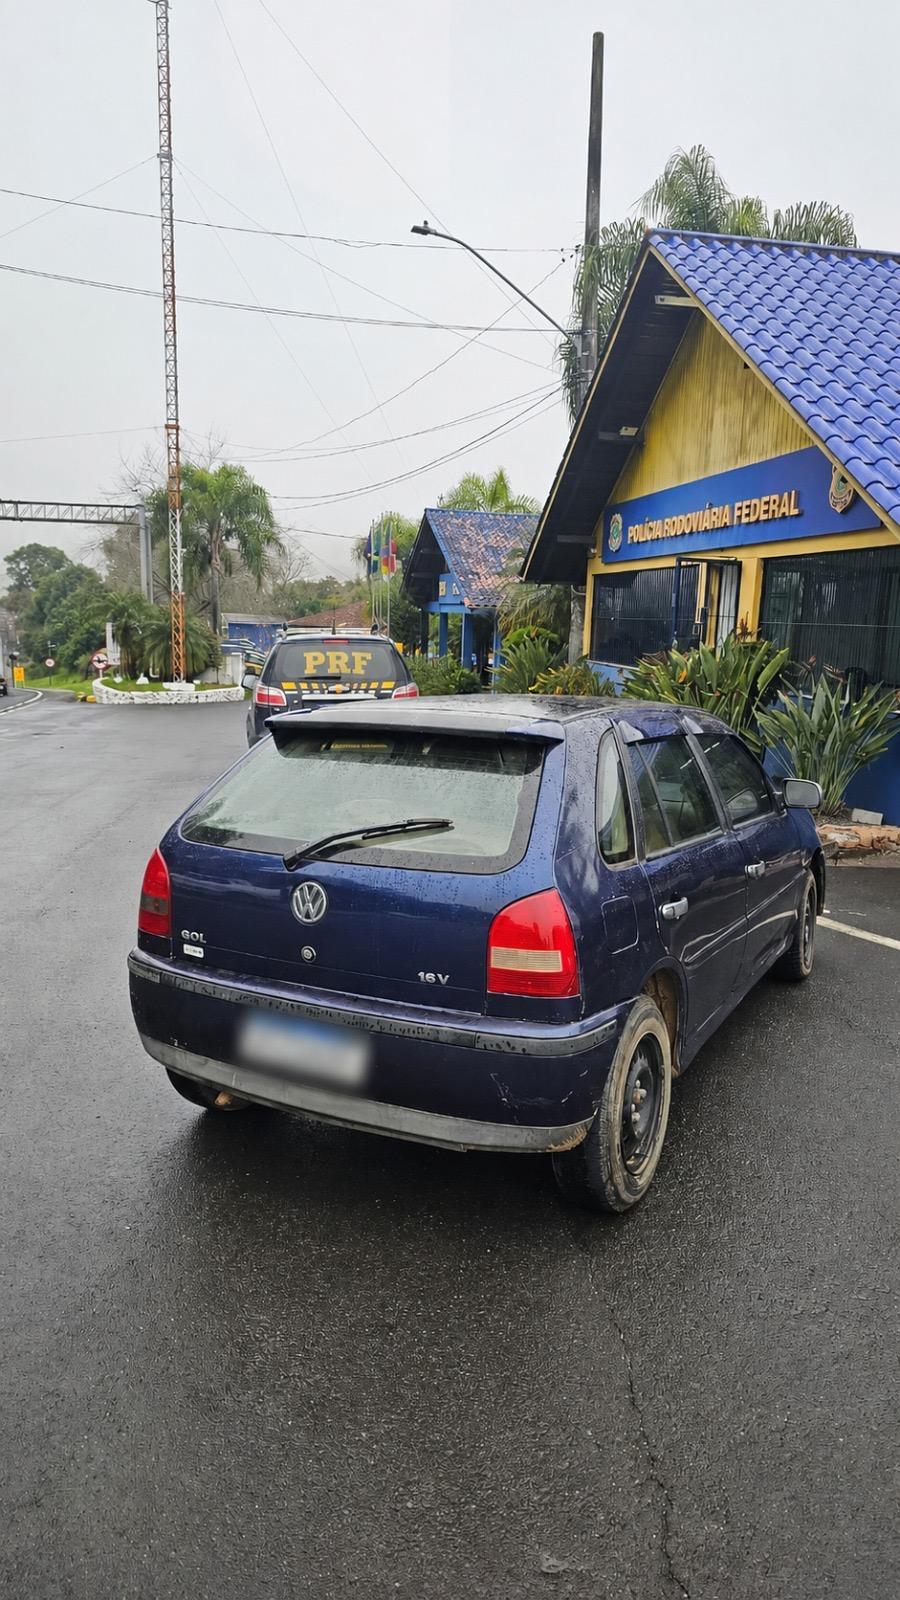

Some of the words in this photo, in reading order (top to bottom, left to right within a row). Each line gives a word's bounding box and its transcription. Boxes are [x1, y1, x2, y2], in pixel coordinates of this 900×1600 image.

[627, 517, 662, 544] POLÍCIA
[663, 502, 731, 537] RODOVIÁRIA
[734, 489, 799, 525] FEDERAL
[303, 651, 372, 675] PRF
[181, 929, 207, 944] GOL
[417, 971, 450, 985] 16V
